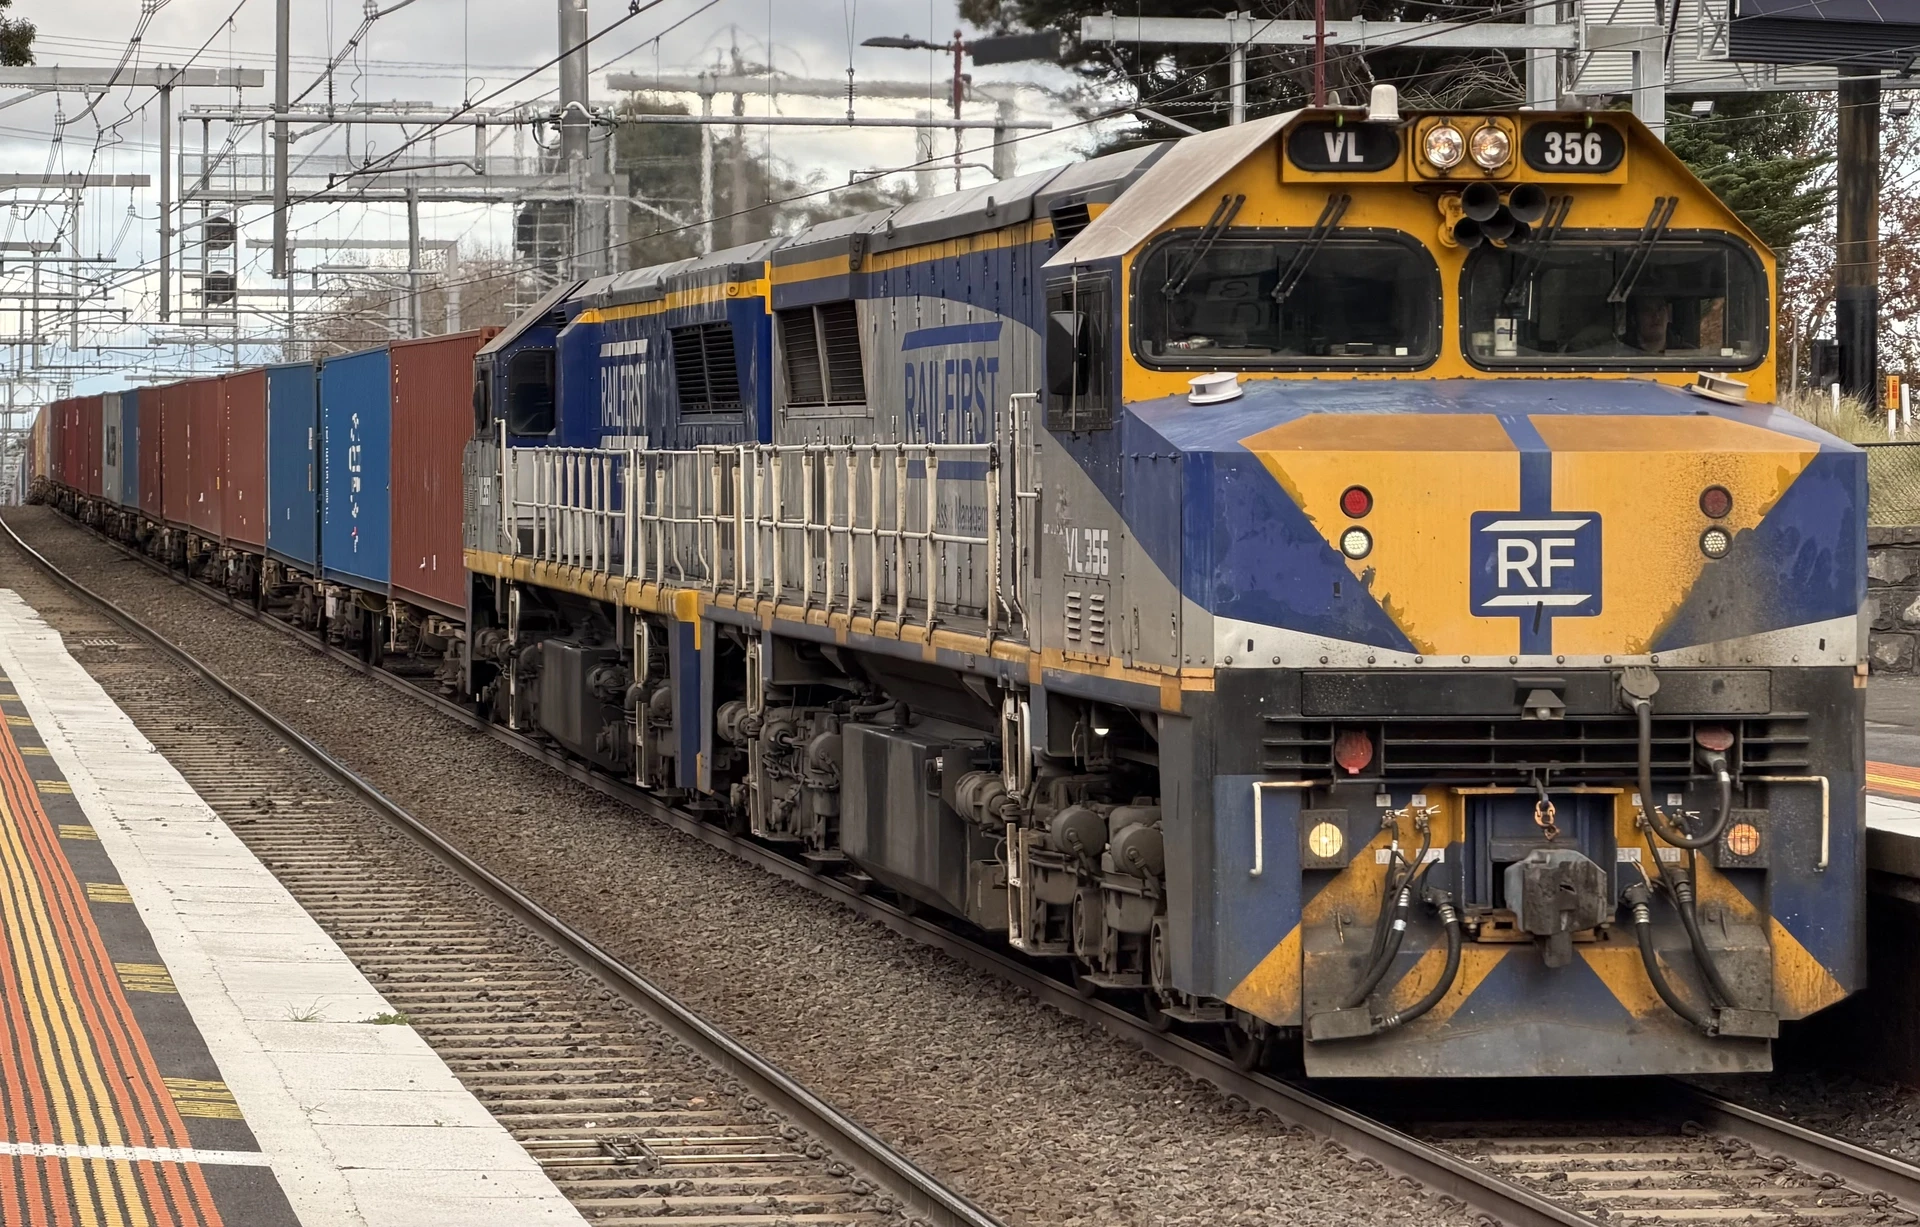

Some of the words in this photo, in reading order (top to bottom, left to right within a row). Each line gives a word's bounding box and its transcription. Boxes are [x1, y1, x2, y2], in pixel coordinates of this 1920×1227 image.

[1324, 131, 1364, 163] VL
[1544, 131, 1602, 165] 356
[601, 362, 646, 427] RAILFIRST
[905, 356, 999, 444] RAILFIRST
[1497, 538, 1576, 588] RF
